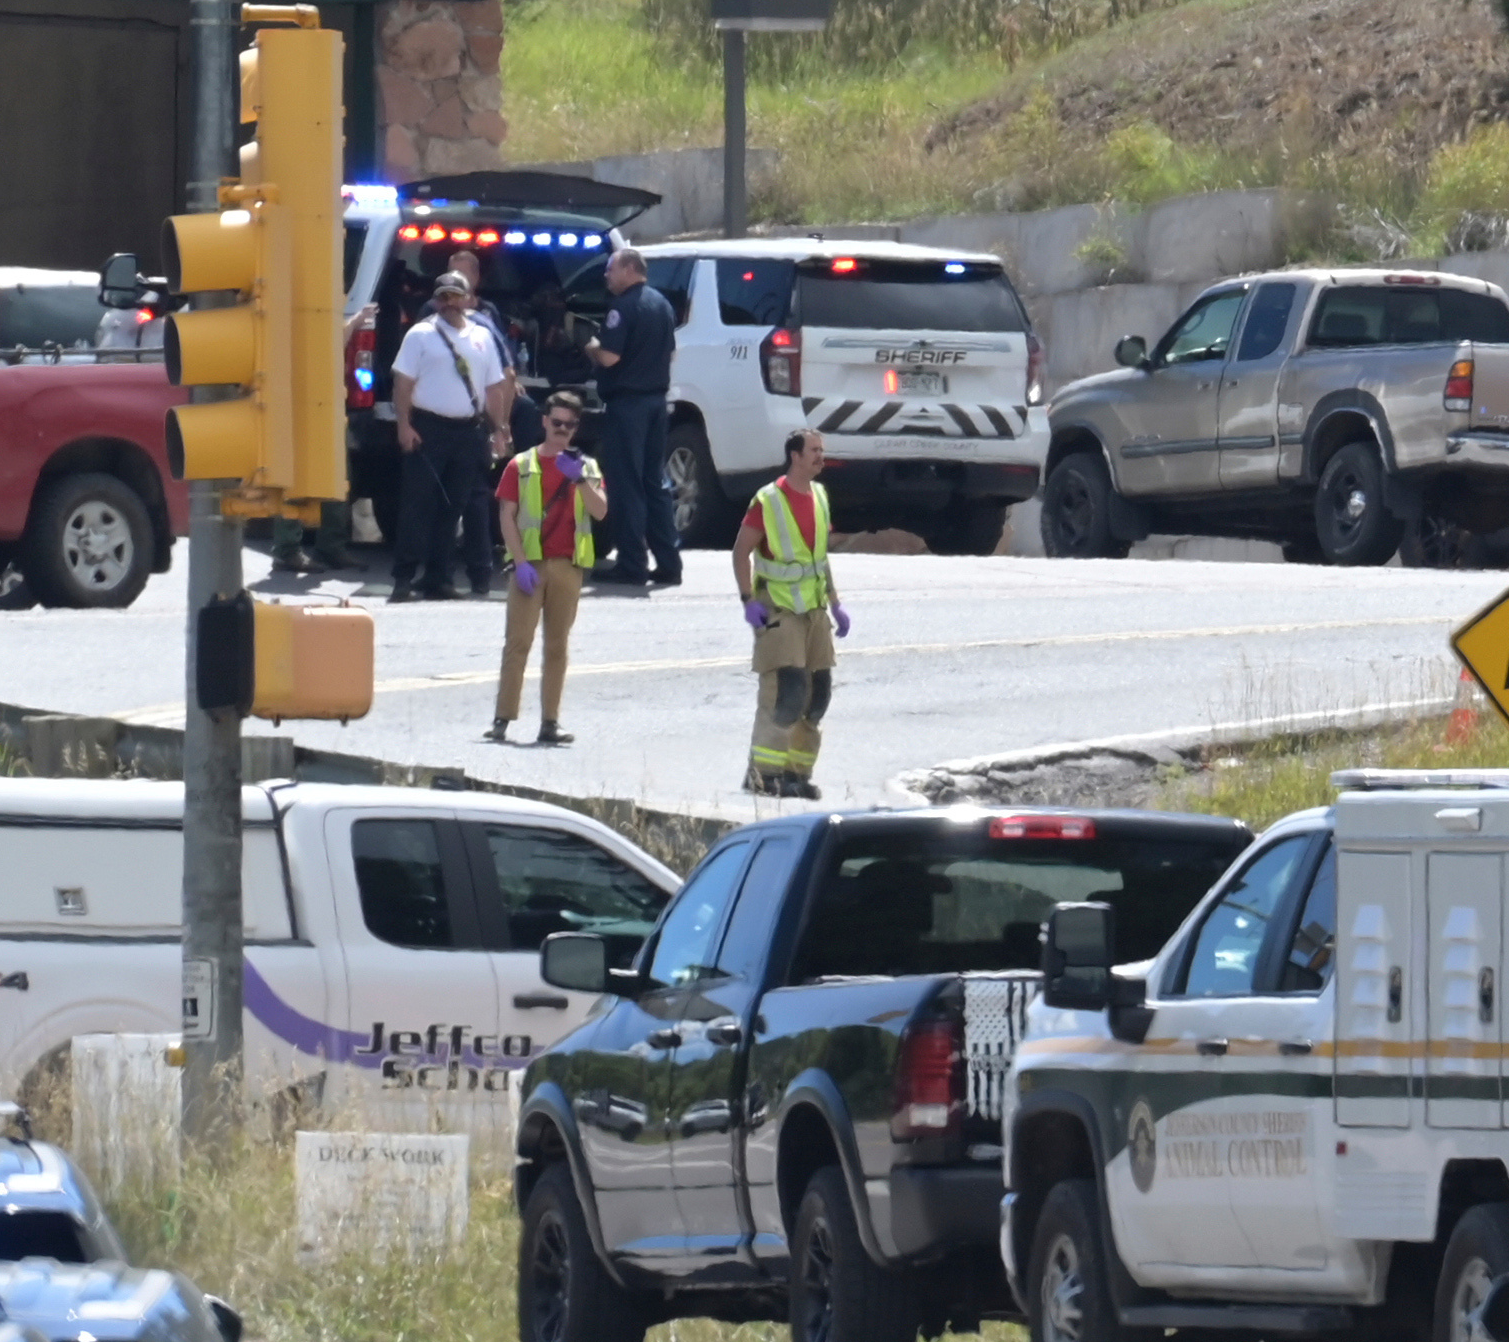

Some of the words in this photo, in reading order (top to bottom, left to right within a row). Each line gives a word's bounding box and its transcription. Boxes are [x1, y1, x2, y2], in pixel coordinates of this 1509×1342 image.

[730, 345, 749, 360] 911
[874, 349, 967, 365] SHERIFF
[354, 1021, 533, 1057] Jeffco
